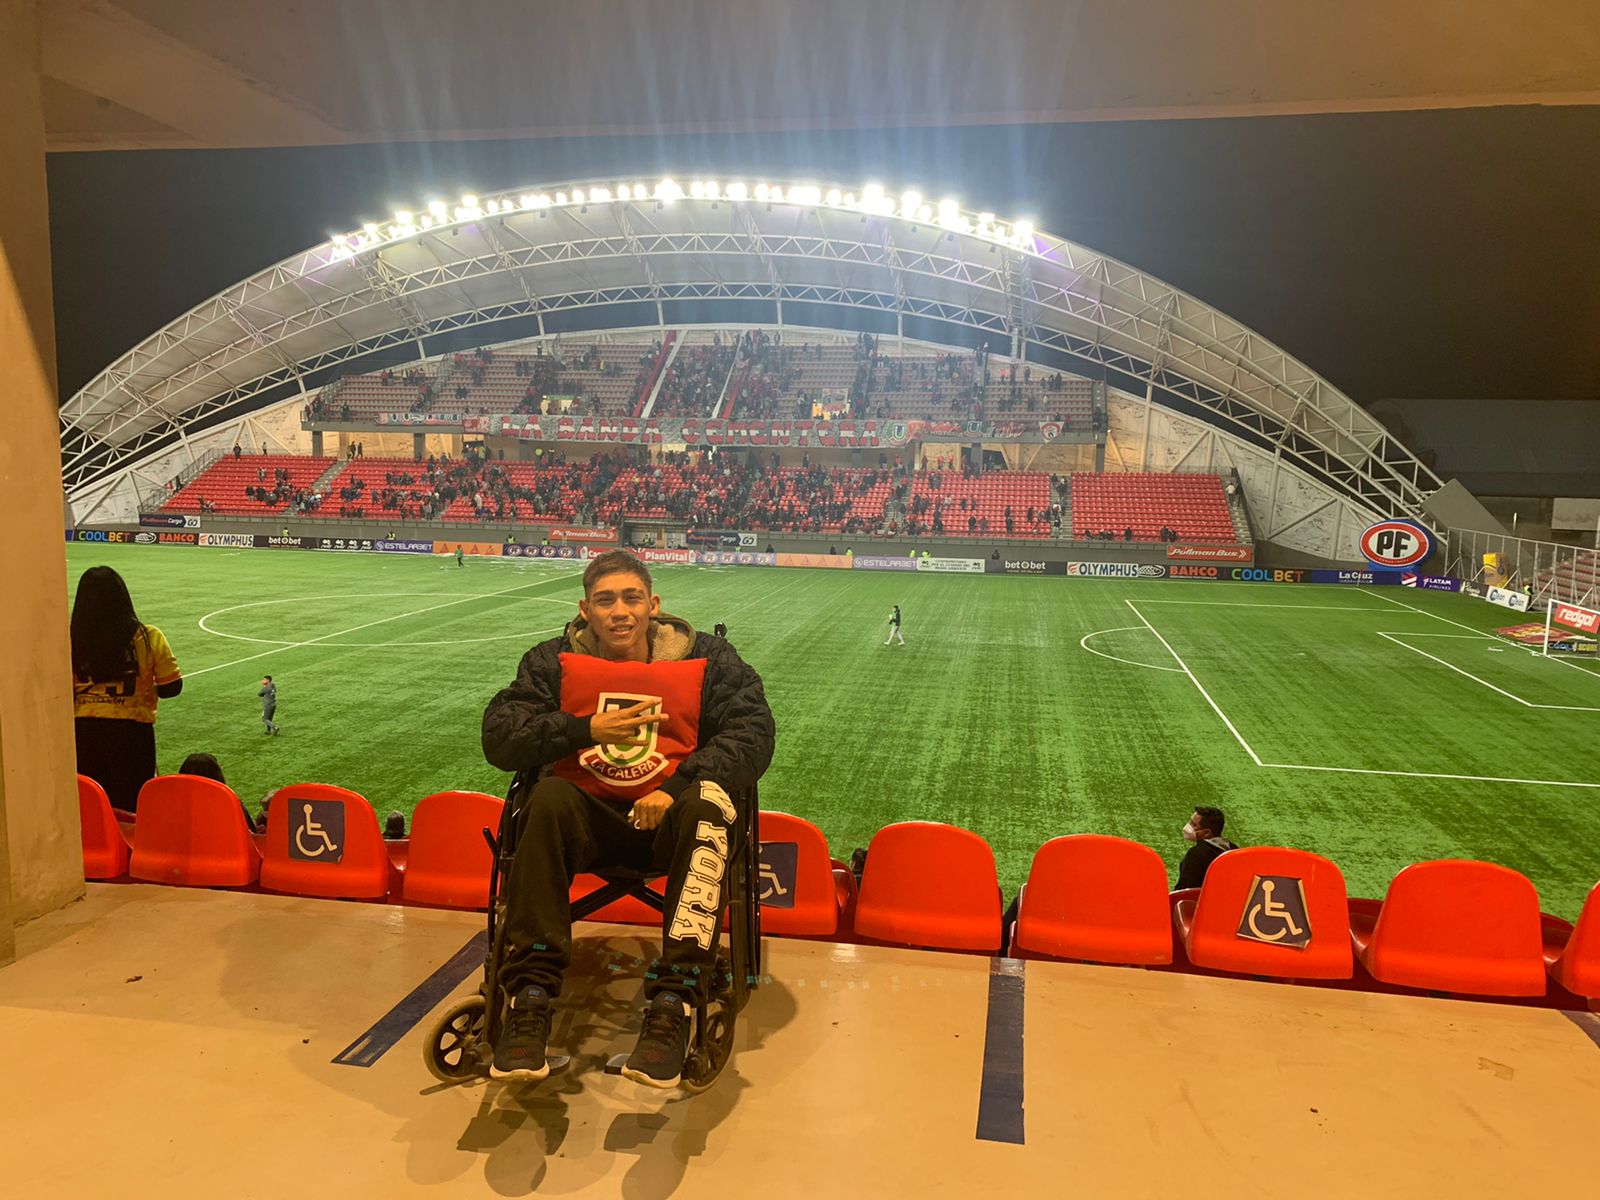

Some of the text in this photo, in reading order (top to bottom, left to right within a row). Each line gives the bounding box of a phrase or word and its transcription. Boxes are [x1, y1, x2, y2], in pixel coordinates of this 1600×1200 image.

[500, 416, 543, 439] LA
[557, 417, 663, 443] BANDA
[681, 418, 880, 447] CEMENTERA
[187, 519, 198, 527] GO
[79, 531, 130, 542] COOLBET
[159, 533, 195, 542] BAHCO
[208, 535, 253, 546] OLYMPHUS
[742, 536, 754, 544] GO
[385, 542, 433, 550] ESTELARBET
[1376, 530, 1411, 558] PF
[645, 552, 688, 560] PlanVital
[1169, 547, 1238, 557] Pullman Bus
[863, 559, 916, 568] ESTELARBET
[1079, 562, 1138, 577] OLYMPHUS
[1169, 565, 1218, 577] BAHCO
[1231, 568, 1304, 582] COOLBET
[1429, 577, 1451, 585] LATAM
[1558, 607, 1597, 628] redgol
[590, 758, 657, 779] LA CALERA
[668, 820, 729, 951] YORK
